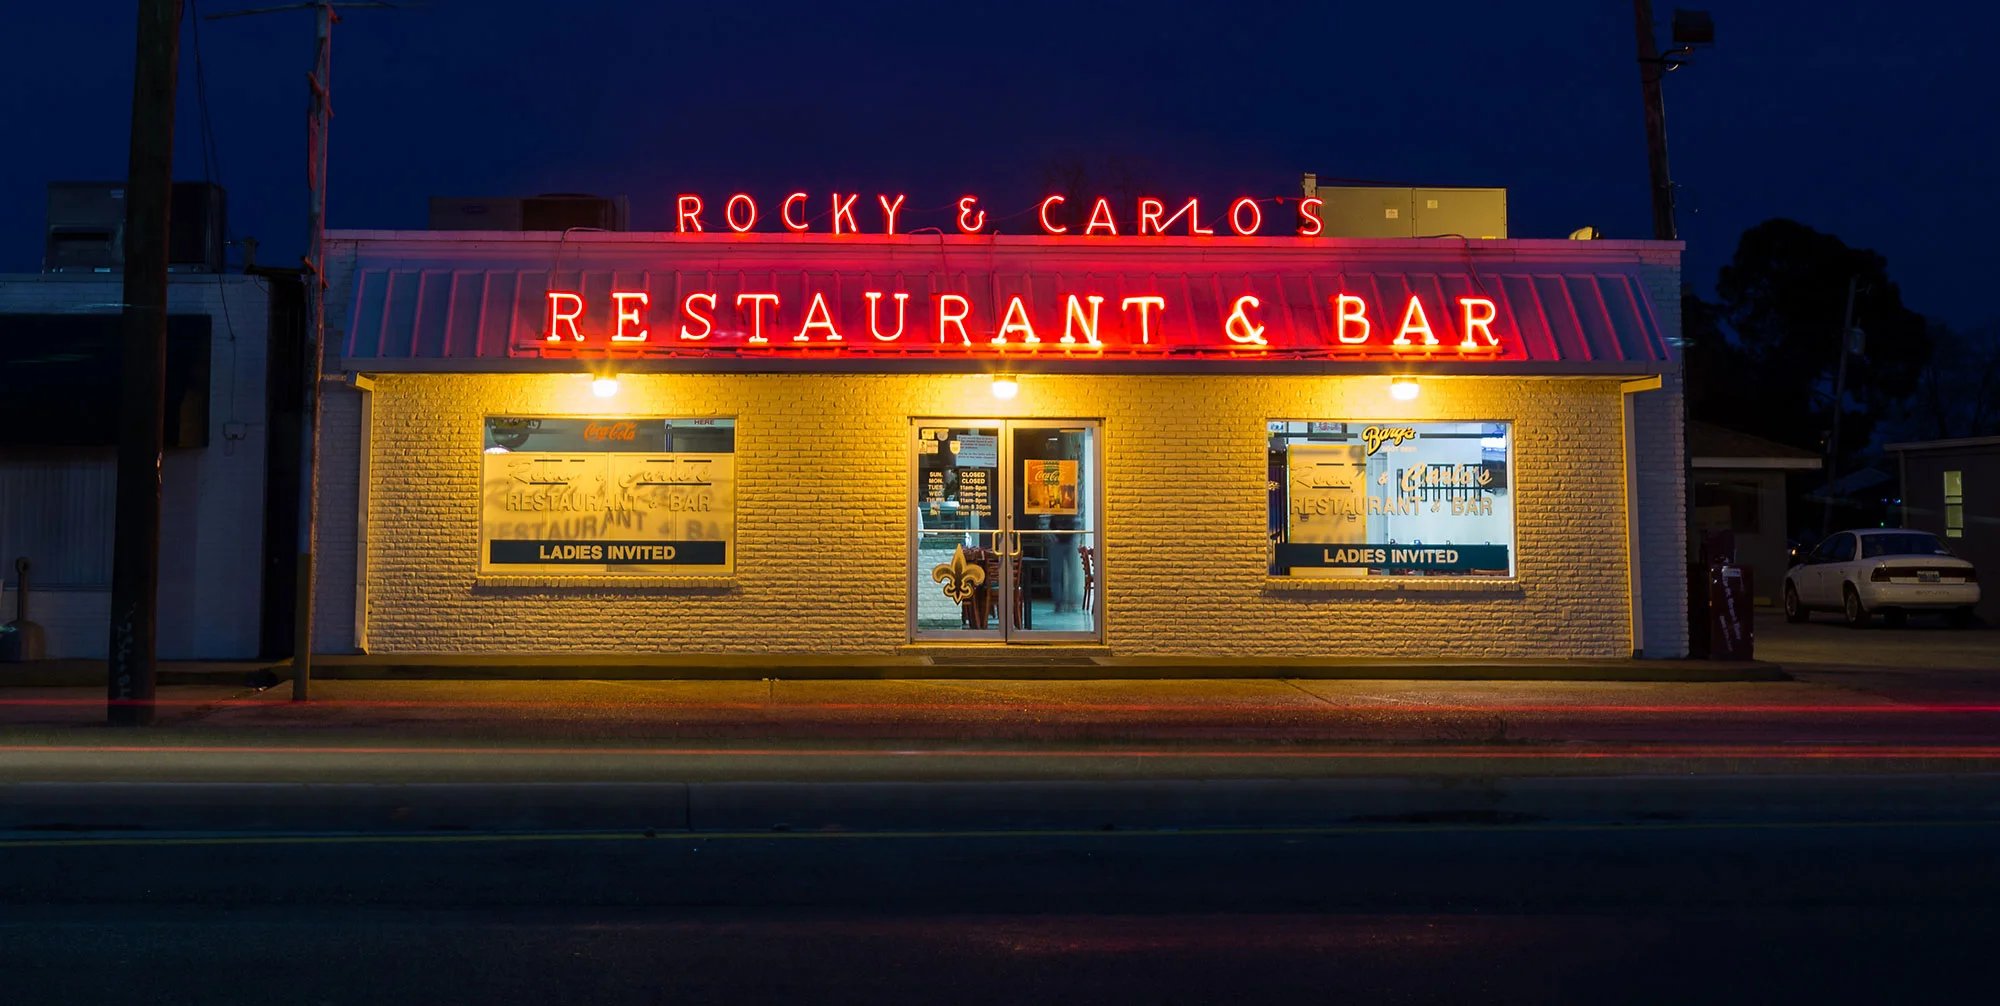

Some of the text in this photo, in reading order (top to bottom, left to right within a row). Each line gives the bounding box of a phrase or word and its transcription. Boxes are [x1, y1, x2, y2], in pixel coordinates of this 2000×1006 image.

[677, 191, 904, 235] ROCKY
[955, 194, 986, 233] &
[545, 290, 1500, 349] RESTAURANT & BAR
[583, 421, 637, 441] Coca-Cola
[1361, 424, 1417, 457] Barq's
[1401, 461, 1493, 492] Carlo's
[504, 492, 640, 512] RESTAURANT
[668, 491, 712, 512] BAR
[1289, 496, 1424, 516] RESTAURANT
[1451, 496, 1494, 516] BAR
[539, 545, 677, 561] LADIES INVITED
[1324, 549, 1459, 564] LADIES INVITED
